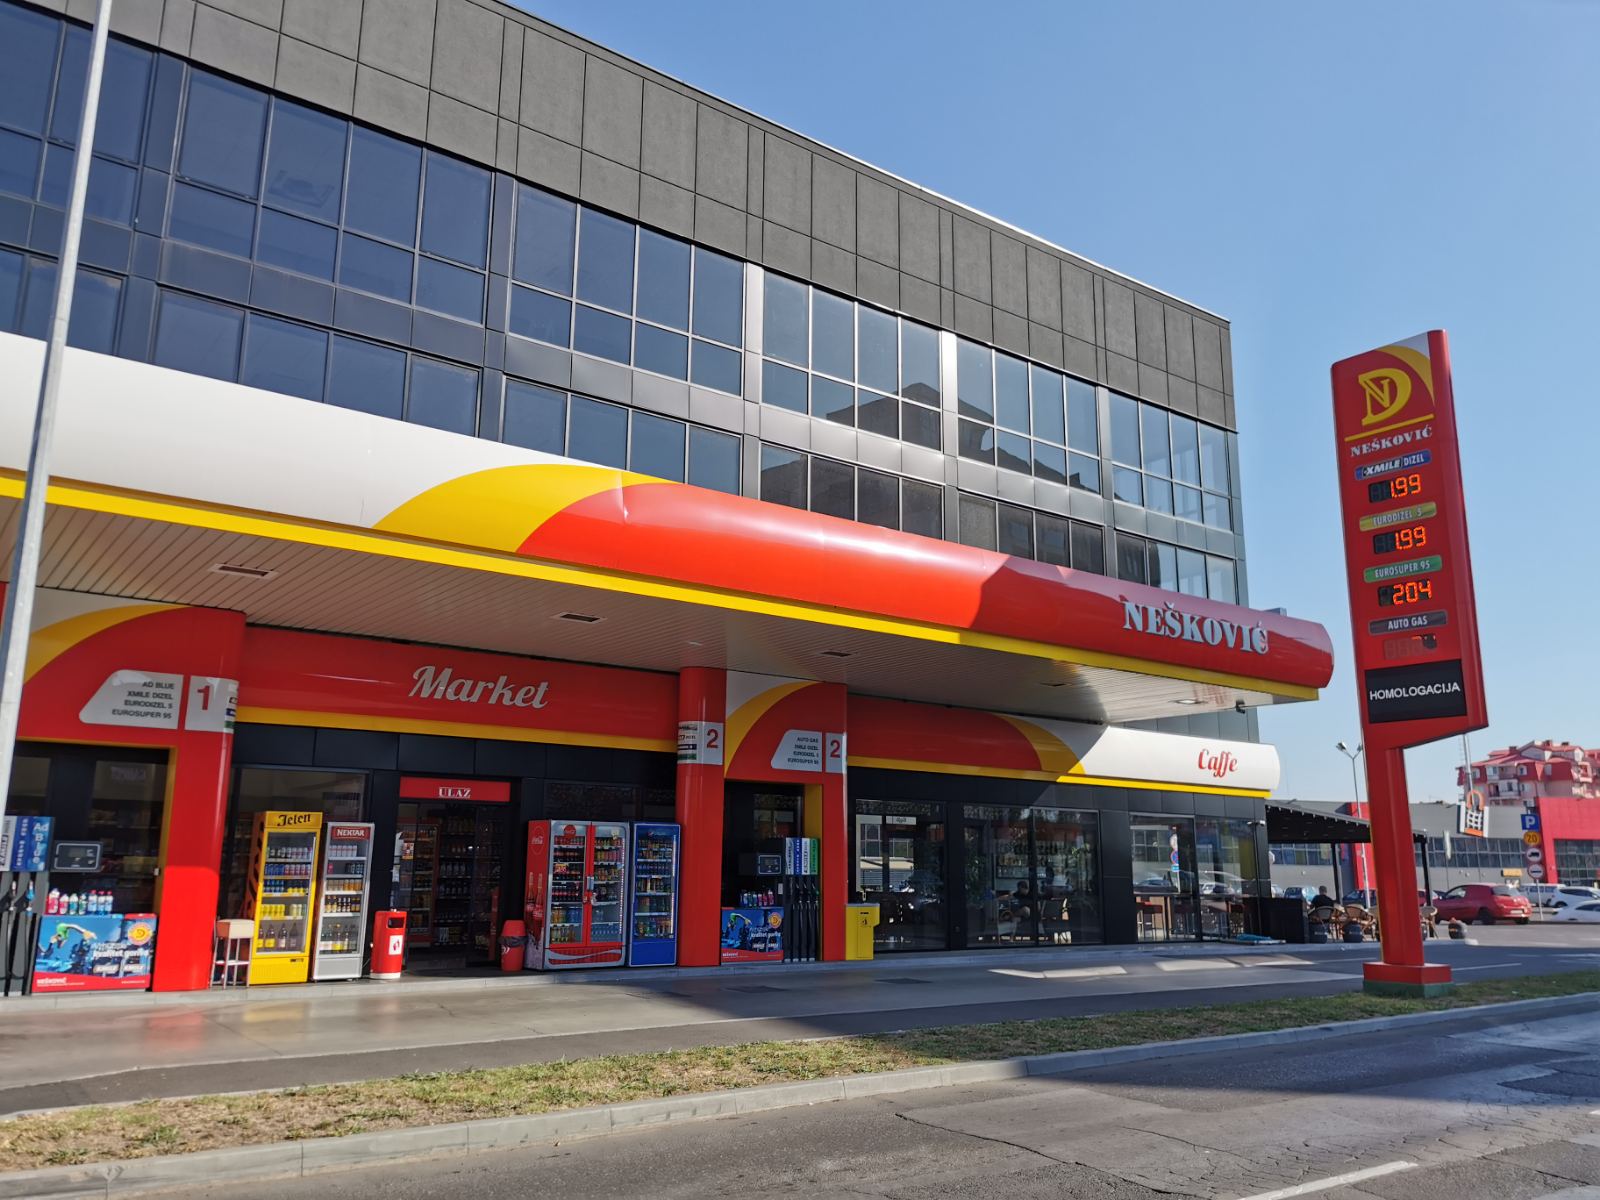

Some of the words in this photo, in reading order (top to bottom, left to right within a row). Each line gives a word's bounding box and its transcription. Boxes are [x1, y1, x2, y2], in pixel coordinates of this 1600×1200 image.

[1350, 424, 1433, 457] NEŠKOVIĆ
[1403, 453, 1425, 466] DIZEL
[1373, 510, 1413, 526] EURODIZEL
[1374, 562, 1418, 578] EUROSUPER
[1420, 560, 1430, 569] 95
[1122, 601, 1269, 655] NEŠKOVIĆ
[1387, 618, 1409, 630] AUTO
[1411, 615, 1428, 626] GAS
[155, 682, 174, 690] BLUE
[408, 665, 549, 709] Market
[1369, 682, 1460, 701] HOMOLOGACIJA
[127, 690, 150, 699] XMILE
[152, 692, 174, 700] DIZEL
[197, 685, 211, 711] 1
[124, 699, 166, 709] EURODIZEL
[112, 708, 161, 718] EUROSUPER
[162, 712, 172, 720] 95
[706, 728, 719, 749] 2
[830, 739, 841, 759] 2
[1198, 748, 1238, 778] Caffe
[439, 786, 472, 799] ULAZ
[277, 813, 311, 827] Jelen
[1525, 815, 1536, 829] P
[336, 828, 365, 837] NEKTAR
[1526, 834, 1538, 843] 20
